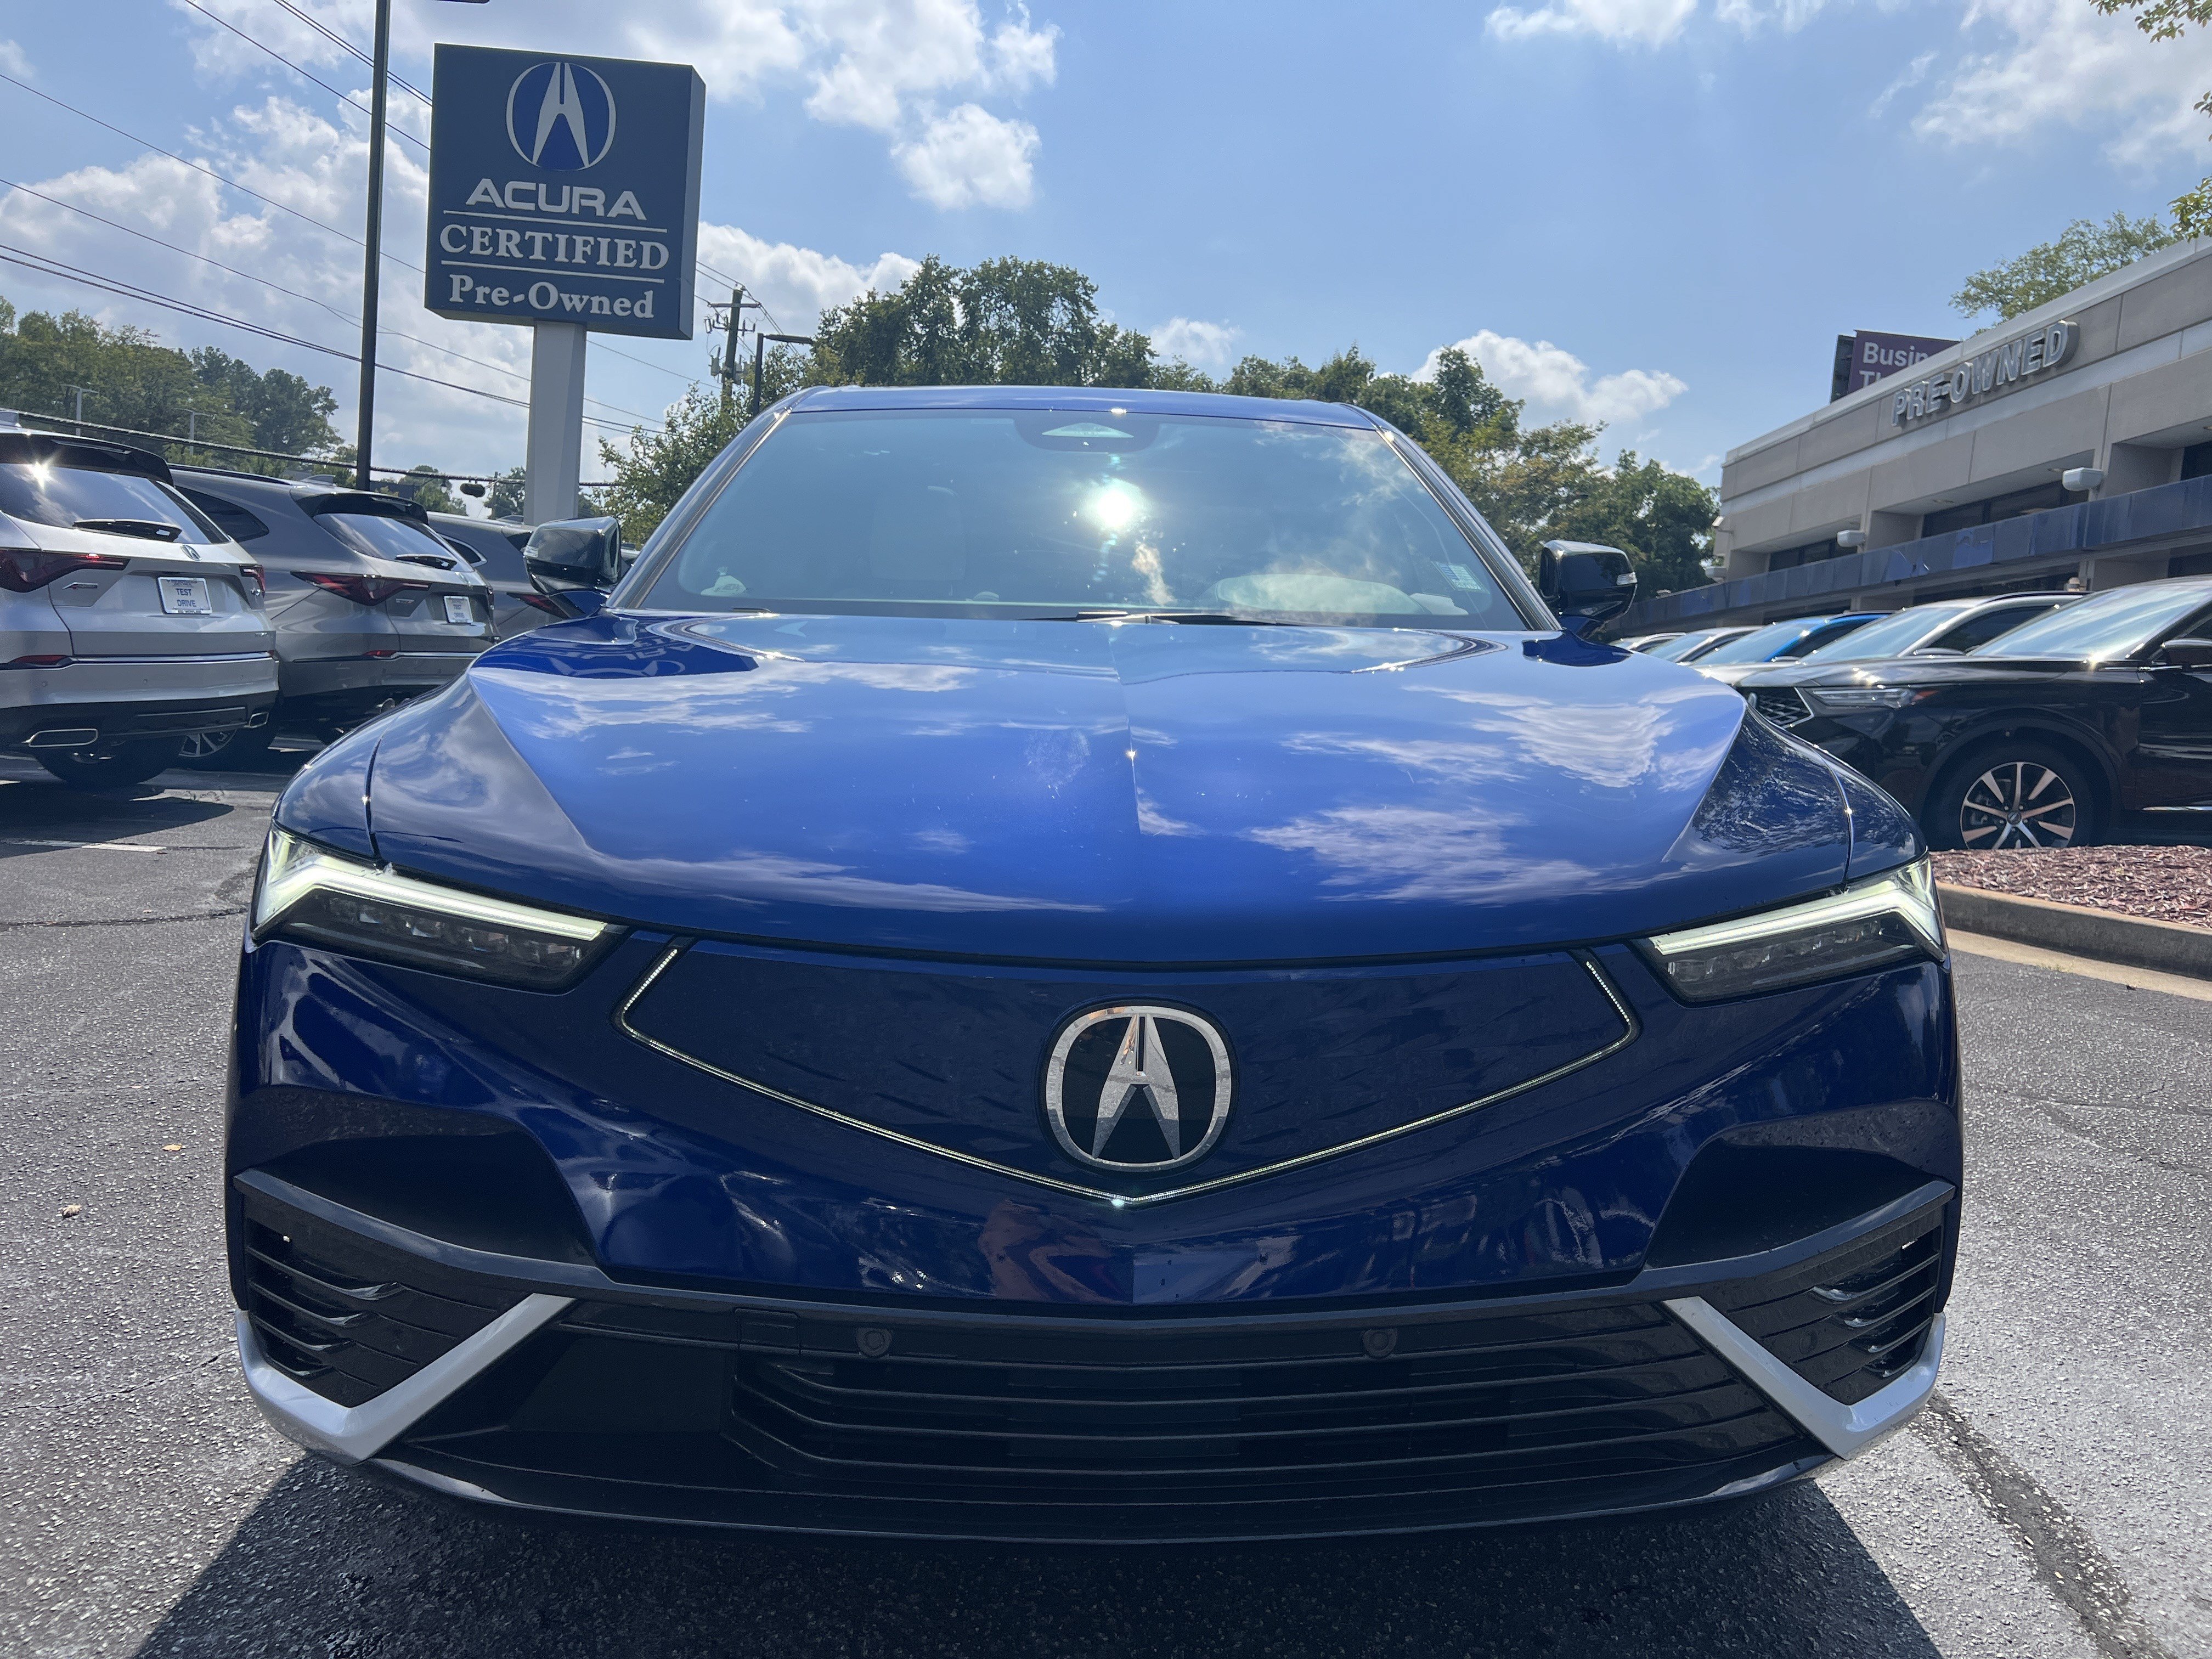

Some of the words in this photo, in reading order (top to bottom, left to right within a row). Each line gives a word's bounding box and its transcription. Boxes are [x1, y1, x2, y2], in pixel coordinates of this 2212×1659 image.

[466, 178, 647, 221] ACURA
[439, 224, 669, 270] CERTIFIED
[449, 274, 654, 319] Pre-Owned
[1892, 321, 2070, 426] PRE-OWNED
[175, 588, 192, 596] TEST
[176, 599, 197, 607] DRIVE
